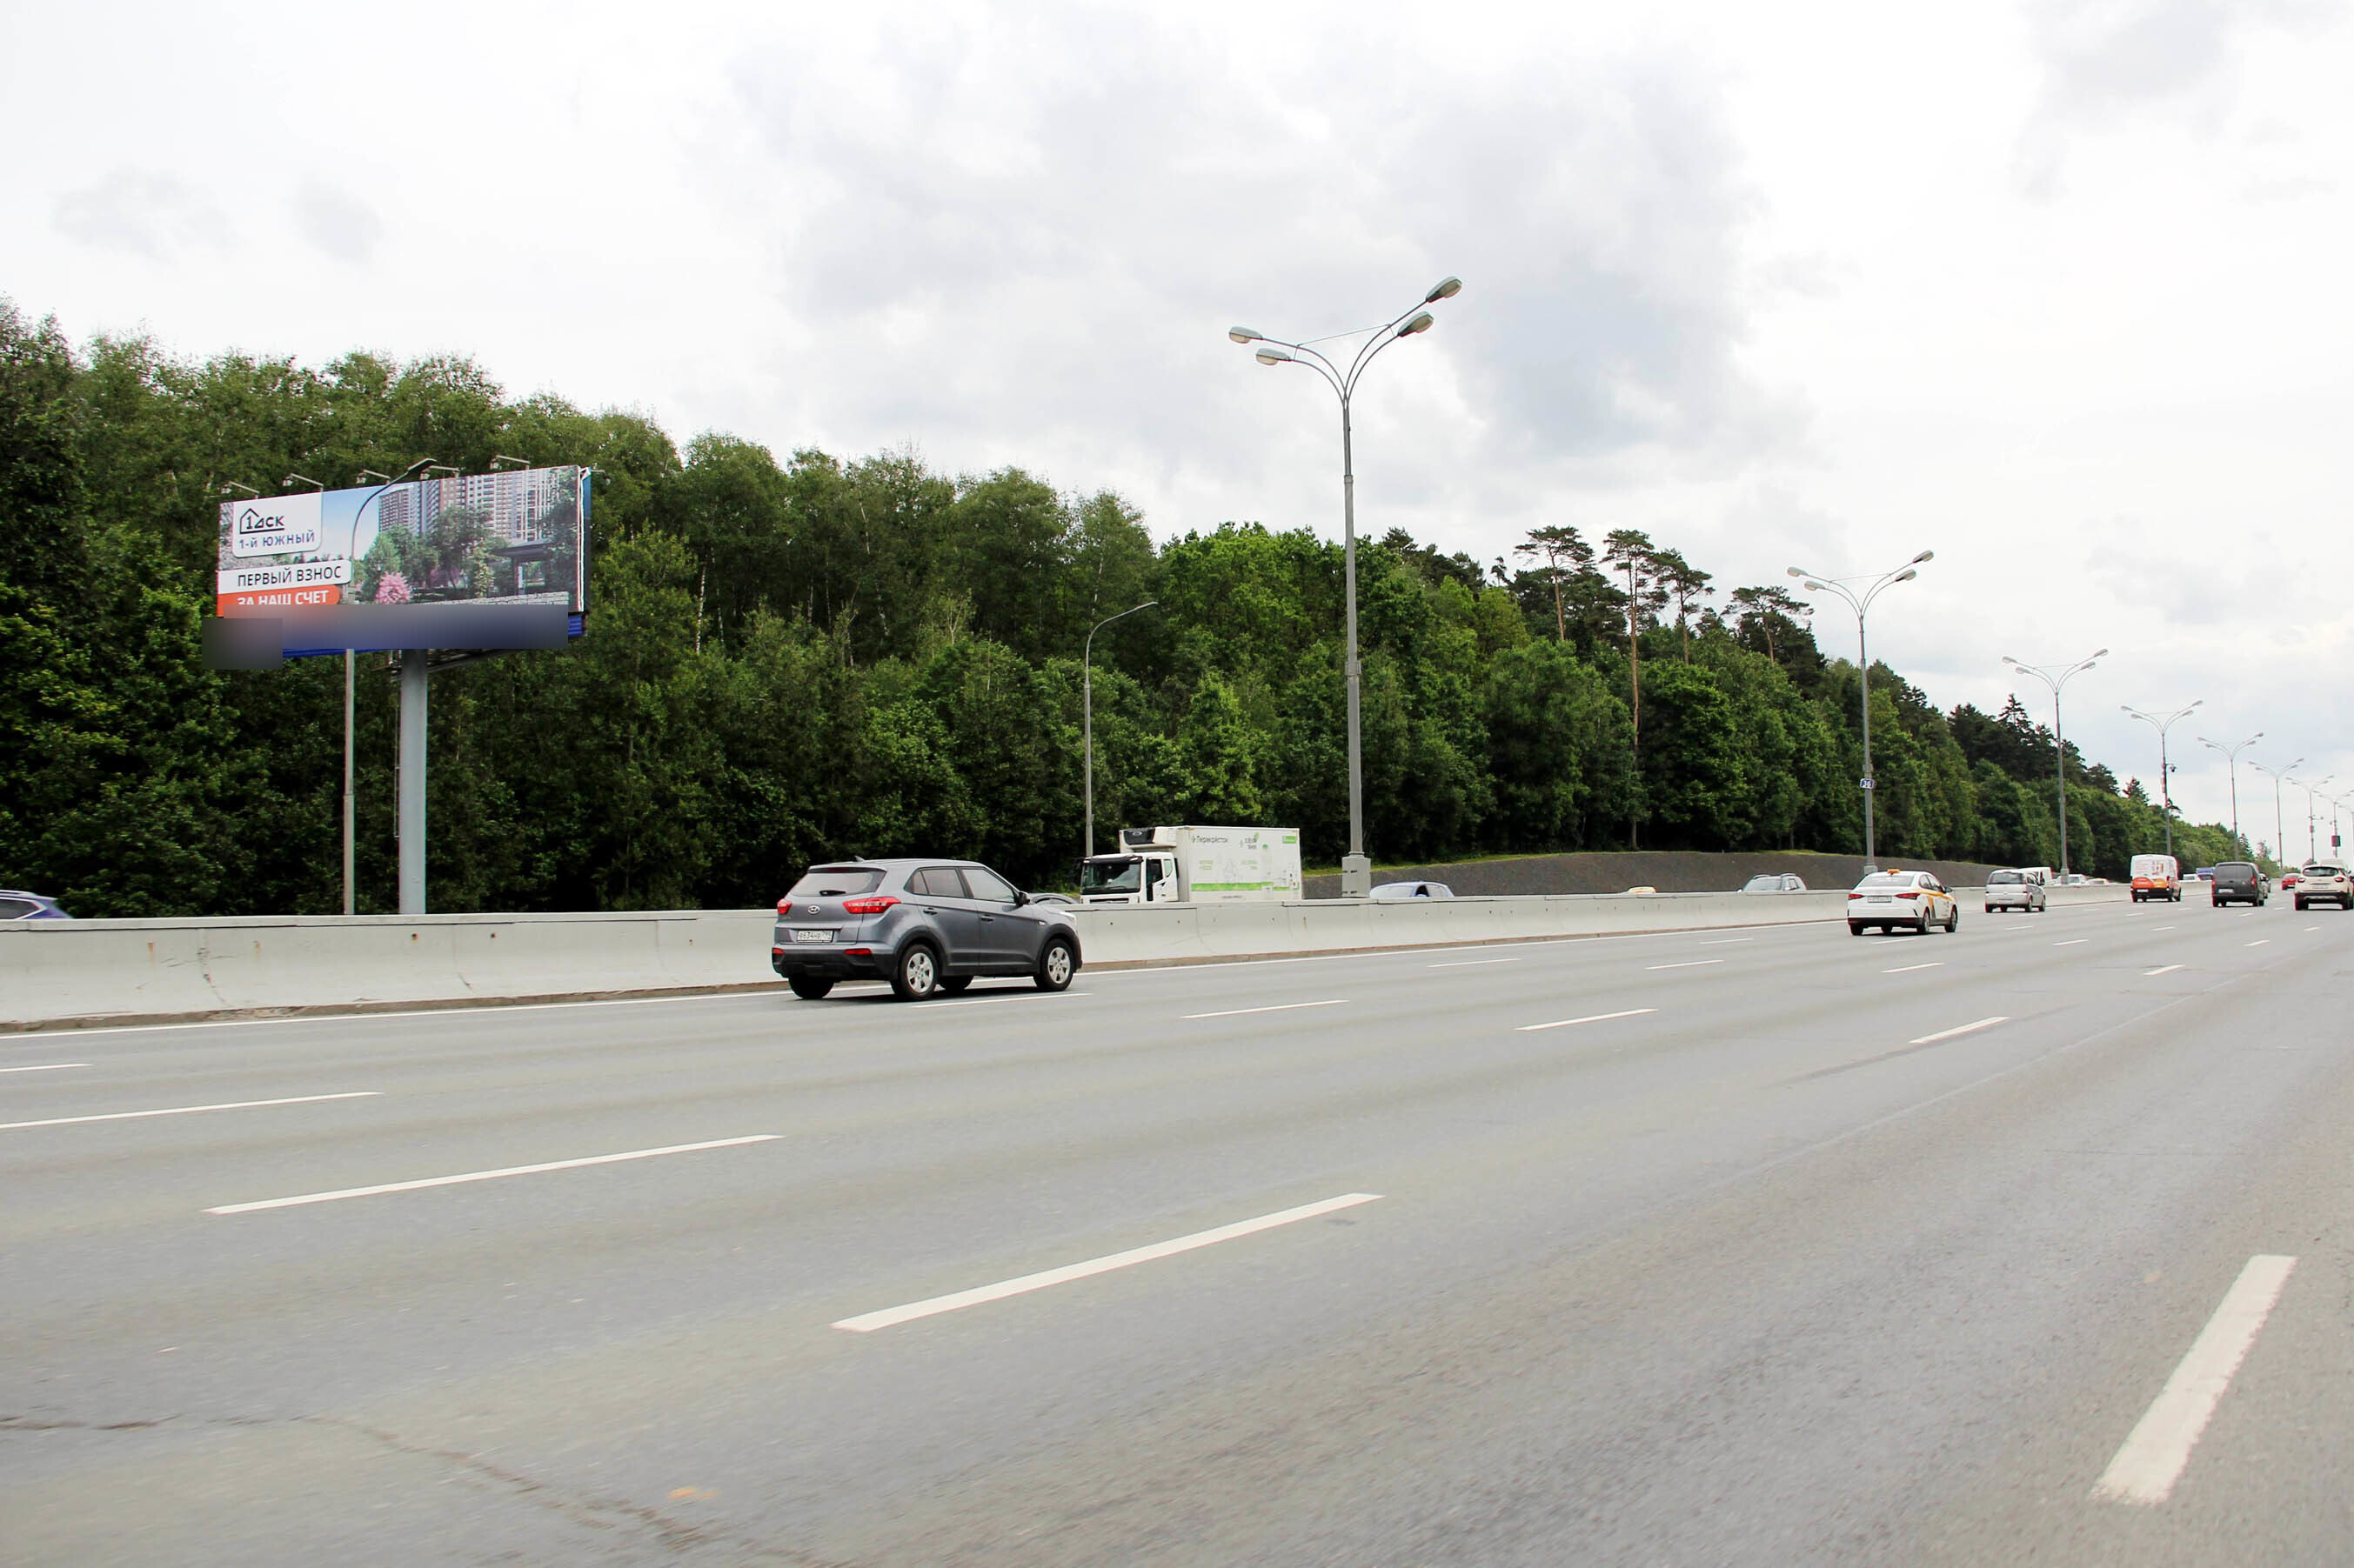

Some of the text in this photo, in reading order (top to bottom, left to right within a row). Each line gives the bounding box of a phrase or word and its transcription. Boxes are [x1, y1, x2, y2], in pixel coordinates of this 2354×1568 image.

[239, 530, 315, 549] 1-й ЮЖНЫЙ
[237, 565, 342, 587] ПЕРВЫЙ ВЗНОС
[258, 592, 291, 605] НАШ
[295, 590, 330, 605] СЧЕТ
